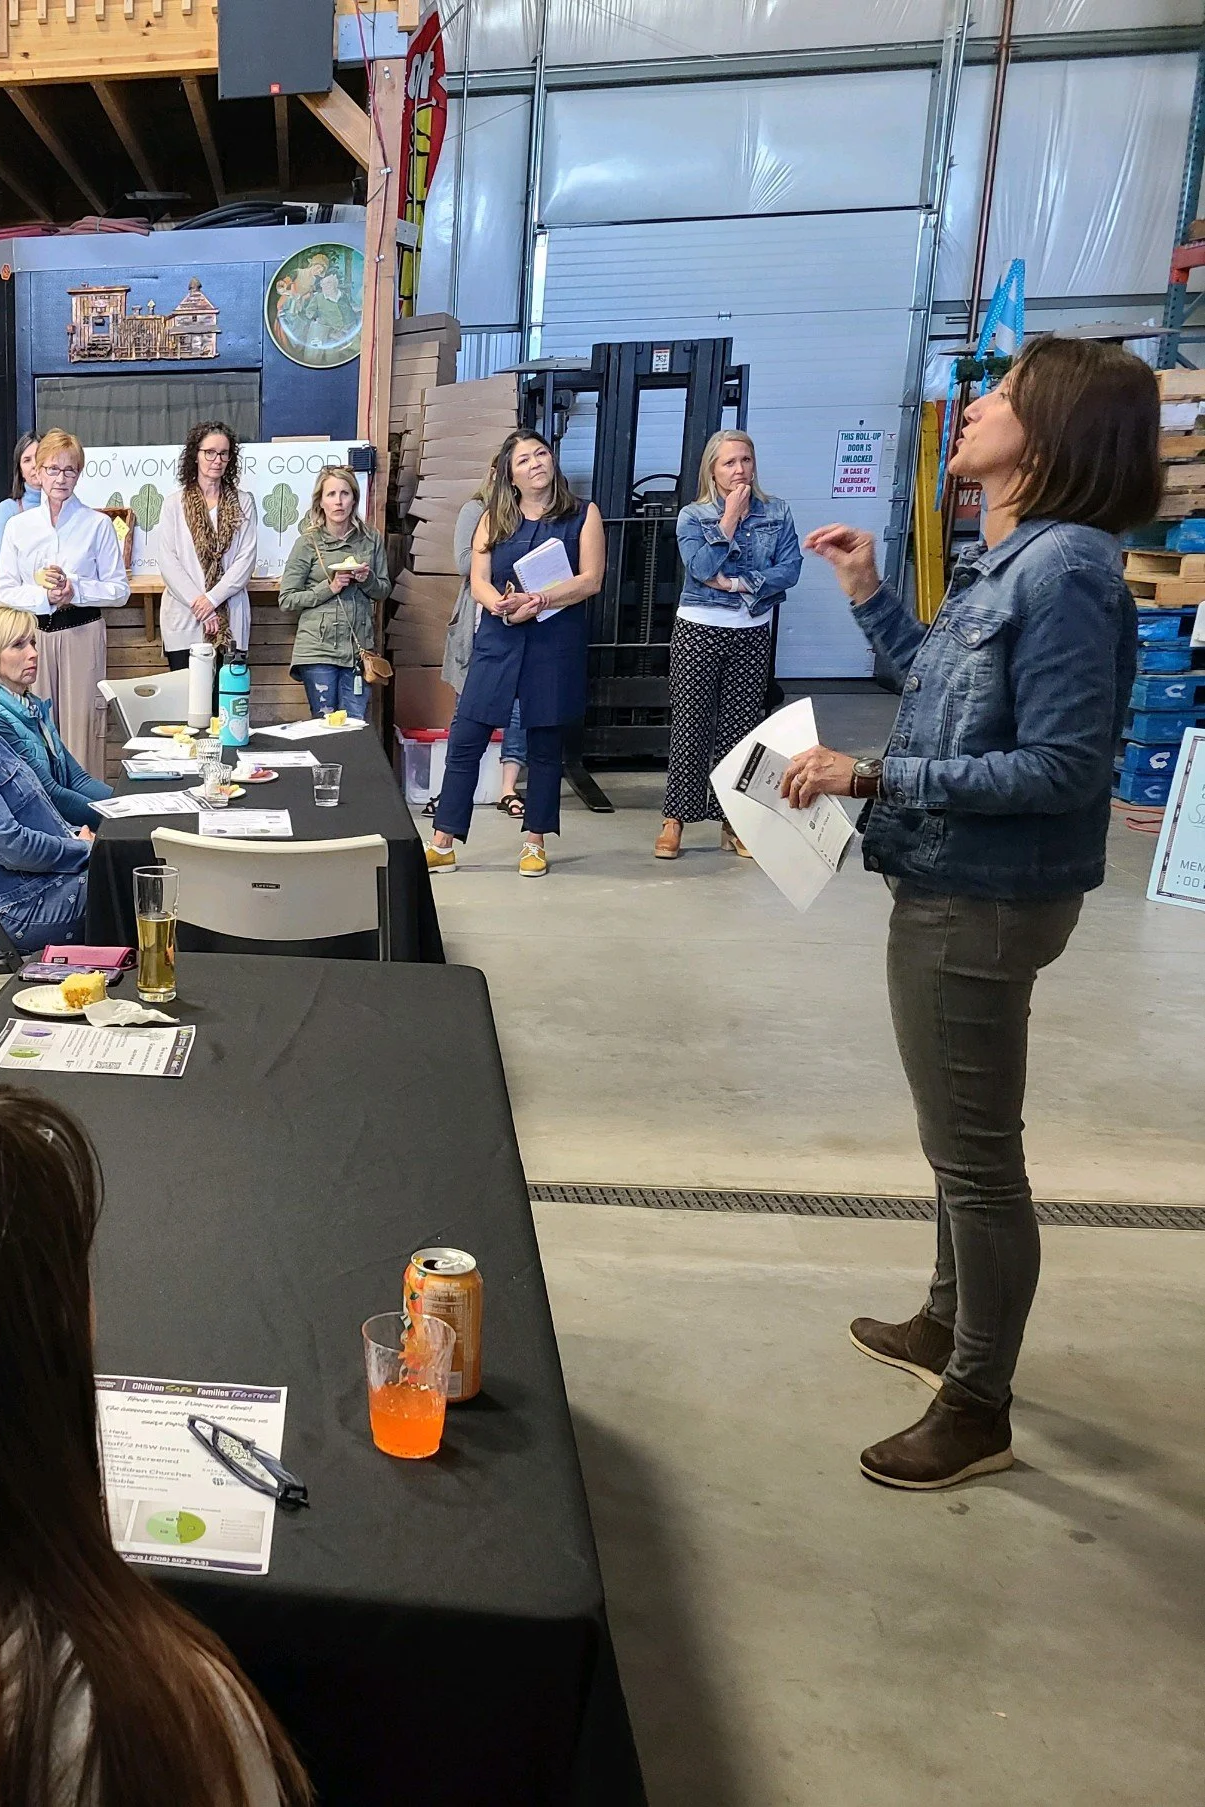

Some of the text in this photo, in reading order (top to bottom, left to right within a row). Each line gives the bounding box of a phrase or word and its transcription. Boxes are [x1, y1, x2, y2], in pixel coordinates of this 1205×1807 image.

[841, 432, 882, 441] THIS ROLL-UP
[847, 443, 872, 452] DOOR IS
[841, 454, 873, 463] UNLOCKED
[122, 458, 176, 477] WOM
[268, 454, 342, 475] GOOD
[843, 467, 871, 475] IN CASE OF
[958, 488, 982, 506] WE
[132, 1382, 165, 1392] Children
[197, 1387, 230, 1398] Families
[136, 1456, 180, 1465] Screened
[109, 1466, 148, 1474] Children
[149, 1469, 192, 1478] Churches
